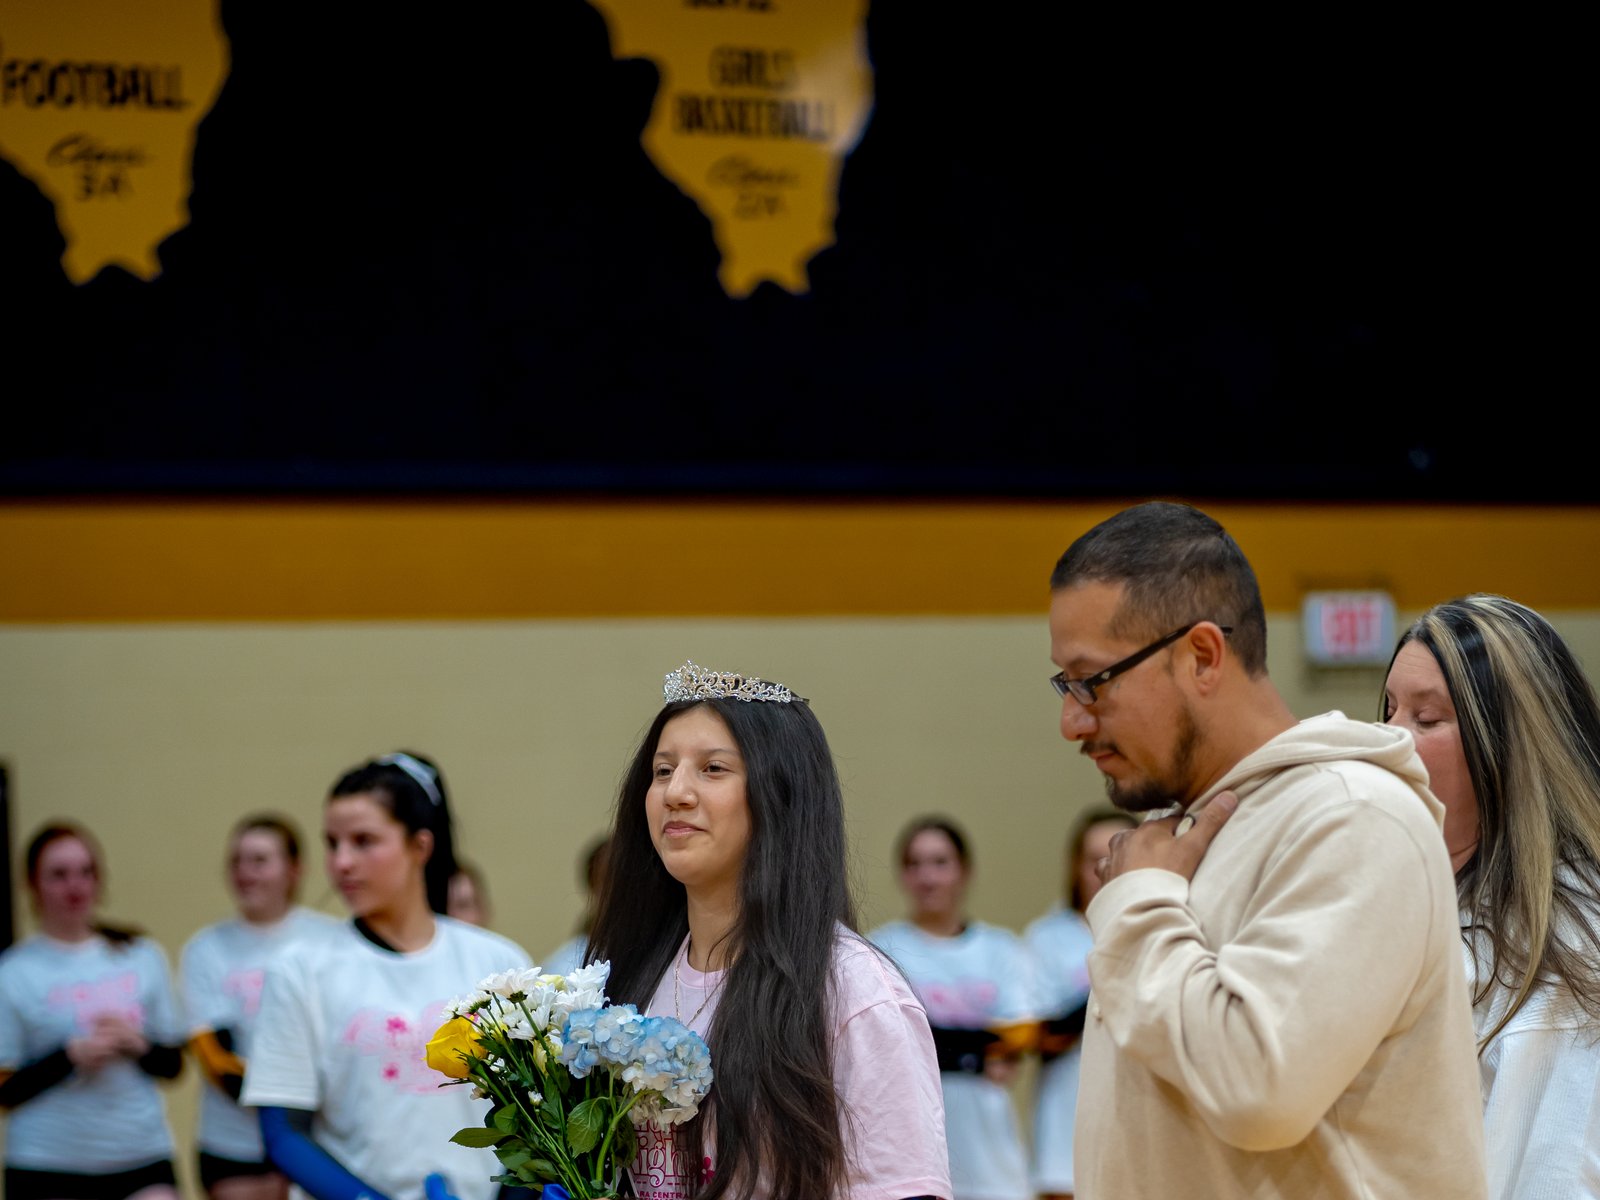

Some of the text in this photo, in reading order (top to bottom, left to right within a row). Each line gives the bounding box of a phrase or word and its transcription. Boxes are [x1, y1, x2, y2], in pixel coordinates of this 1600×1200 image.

[3, 59, 188, 112] FOOTBALL
[673, 94, 836, 142] BASKETBALL
[652, 1191, 691, 1199] CENTRA
